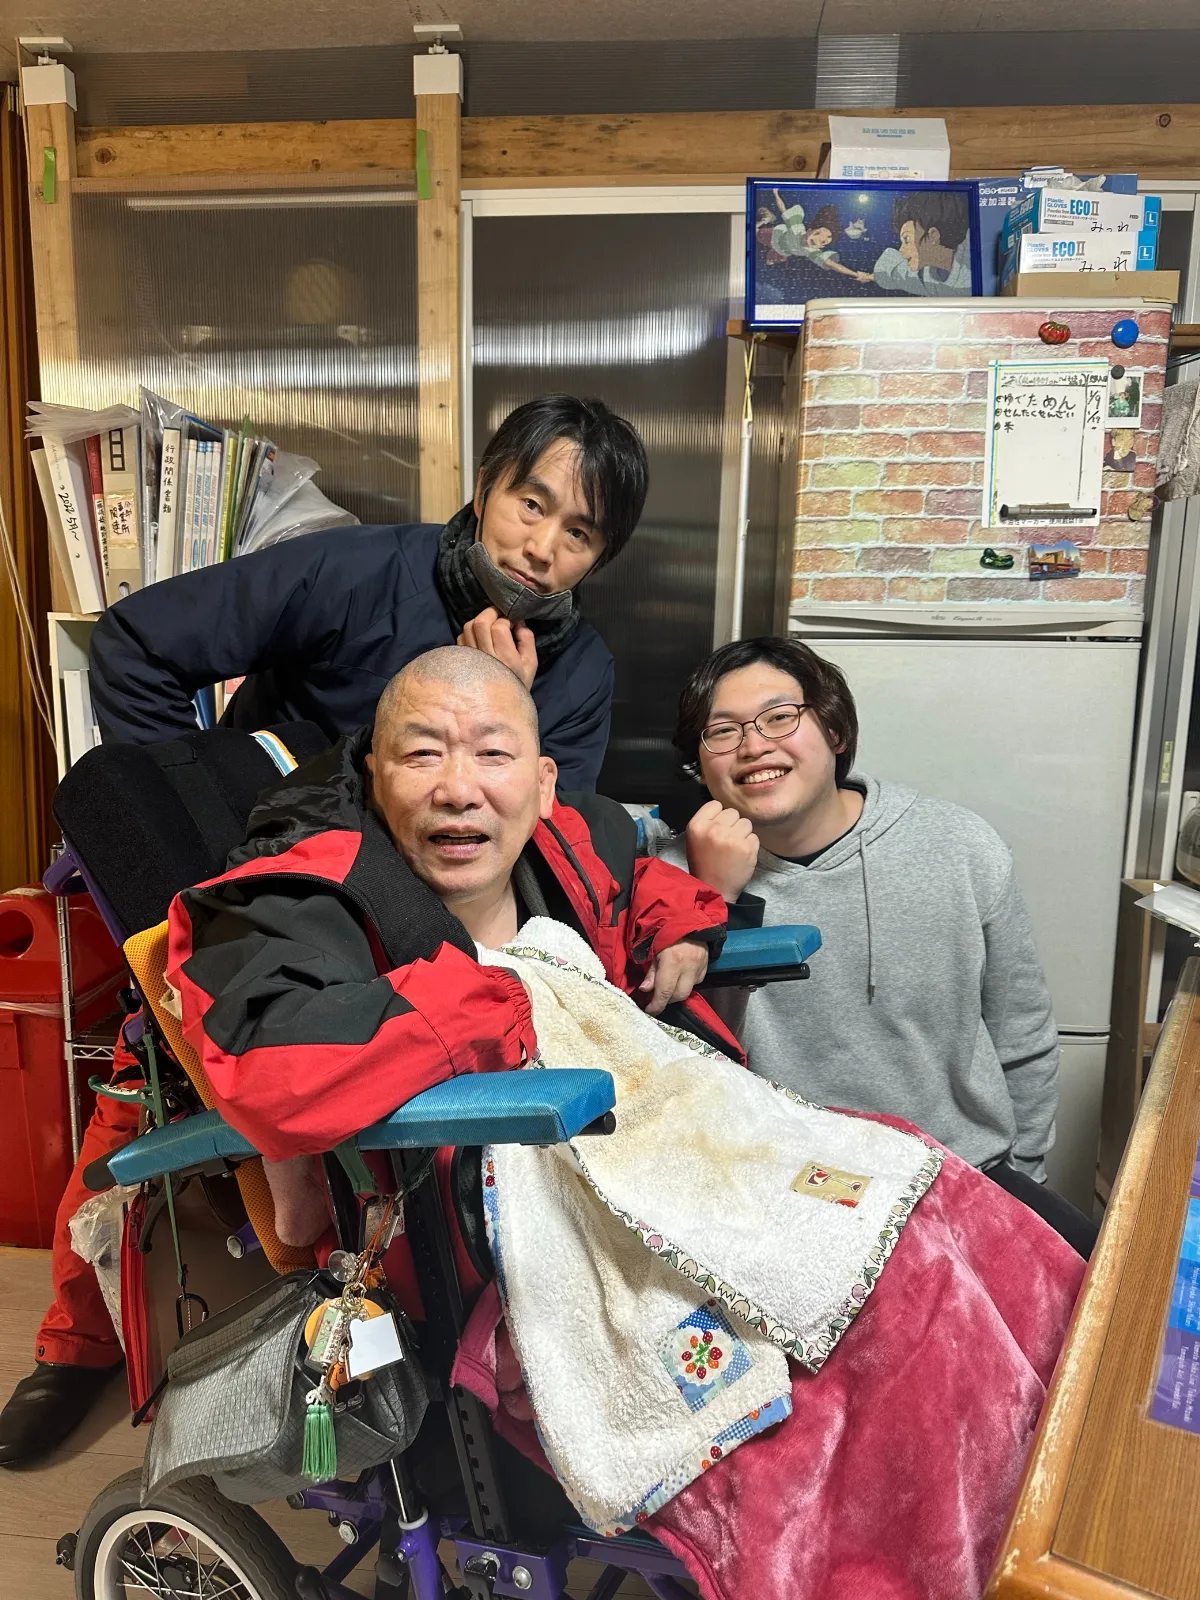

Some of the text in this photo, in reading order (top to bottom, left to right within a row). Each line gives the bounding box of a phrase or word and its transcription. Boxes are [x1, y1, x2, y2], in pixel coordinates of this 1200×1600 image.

[1149, 213, 1154, 222] L
[1143, 247, 1149, 256] L
[58, 492, 75, 514] 2022
